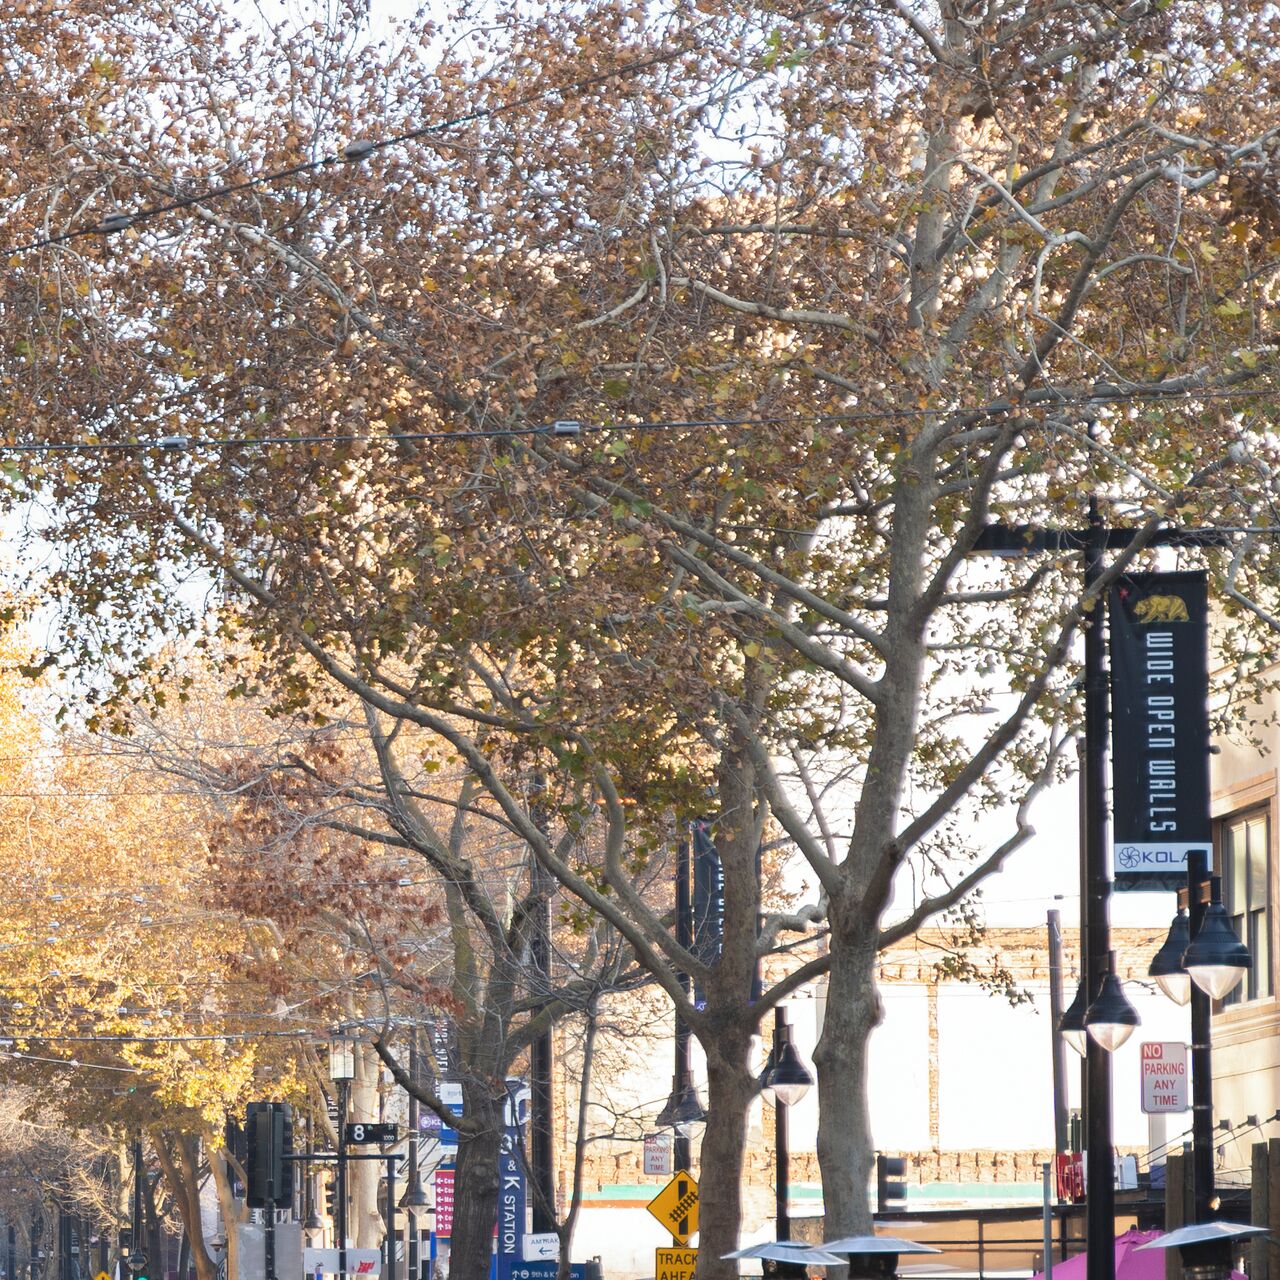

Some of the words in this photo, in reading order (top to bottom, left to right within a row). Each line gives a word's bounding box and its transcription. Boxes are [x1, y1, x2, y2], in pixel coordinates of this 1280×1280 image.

[1146, 632, 1174, 685] WIDE
[1147, 696, 1176, 749] OPEN
[1148, 759, 1177, 832] WALLS
[1142, 850, 1189, 864] KOLA
[1144, 1045, 1162, 1058] NO
[1144, 1063, 1185, 1075] PARKING
[1153, 1080, 1177, 1090] ANY
[1153, 1095, 1179, 1106] TIME
[504, 1176, 521, 1190] K
[504, 1195, 516, 1254] STATION
[659, 1253, 698, 1265] TRACK
